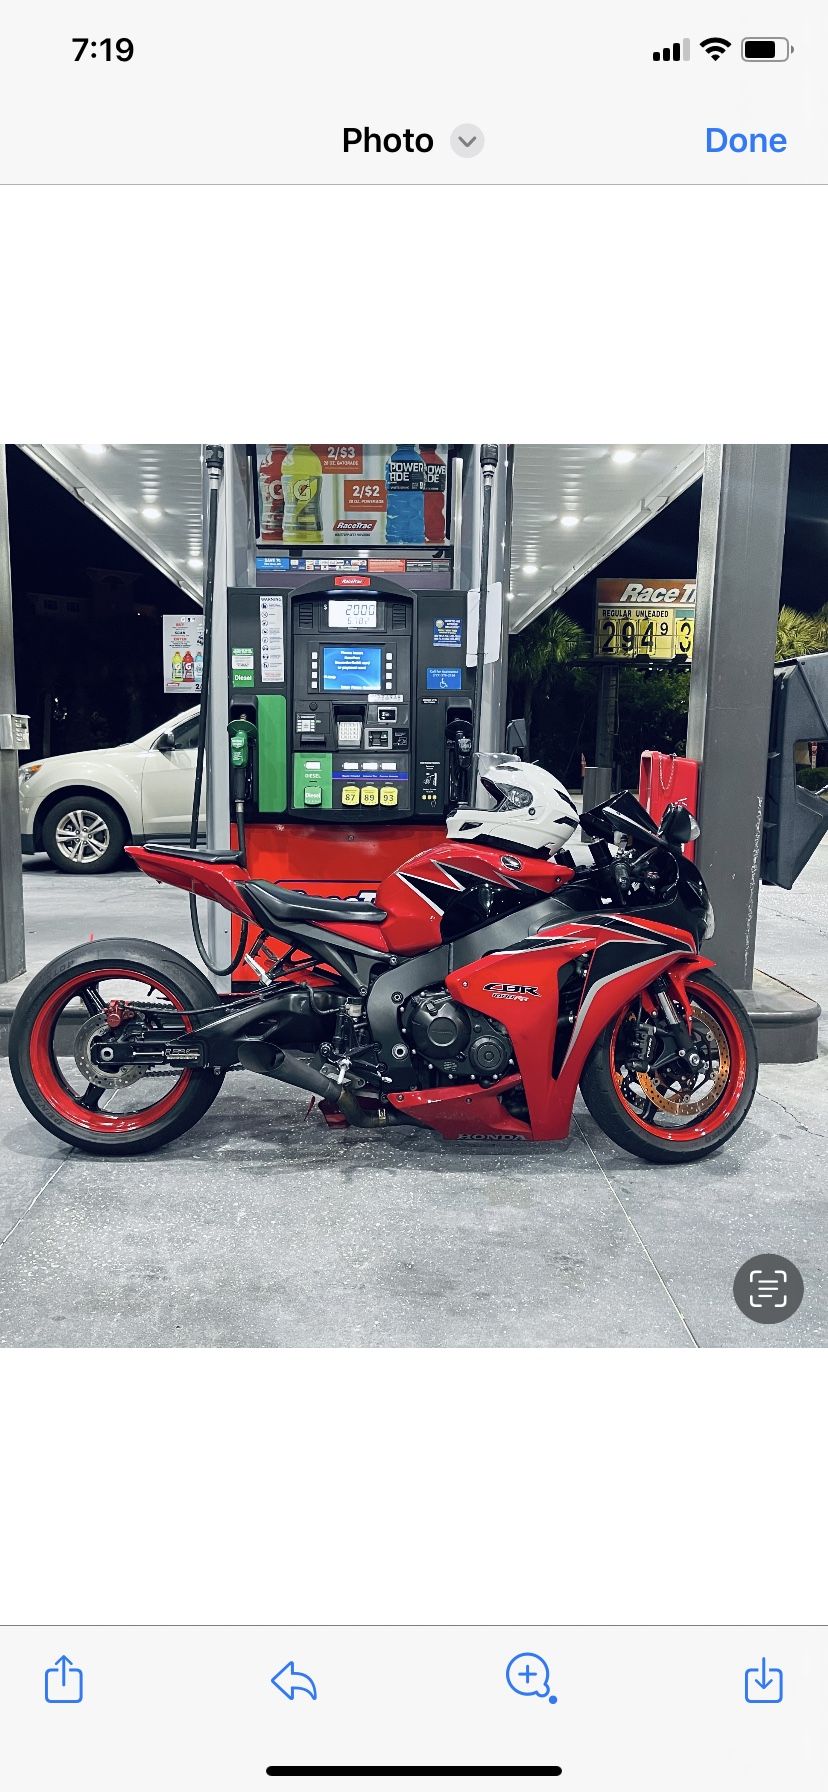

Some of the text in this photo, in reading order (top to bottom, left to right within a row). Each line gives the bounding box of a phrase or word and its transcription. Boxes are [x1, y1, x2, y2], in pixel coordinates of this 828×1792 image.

[327, 446, 356, 460] 2/$3
[390, 462, 424, 472] POWER
[389, 472, 410, 482] ADE
[352, 486, 380, 498] 2/$2
[602, 610, 669, 618] REGULAR UNLEADED
[482, 983, 542, 997] CBR
